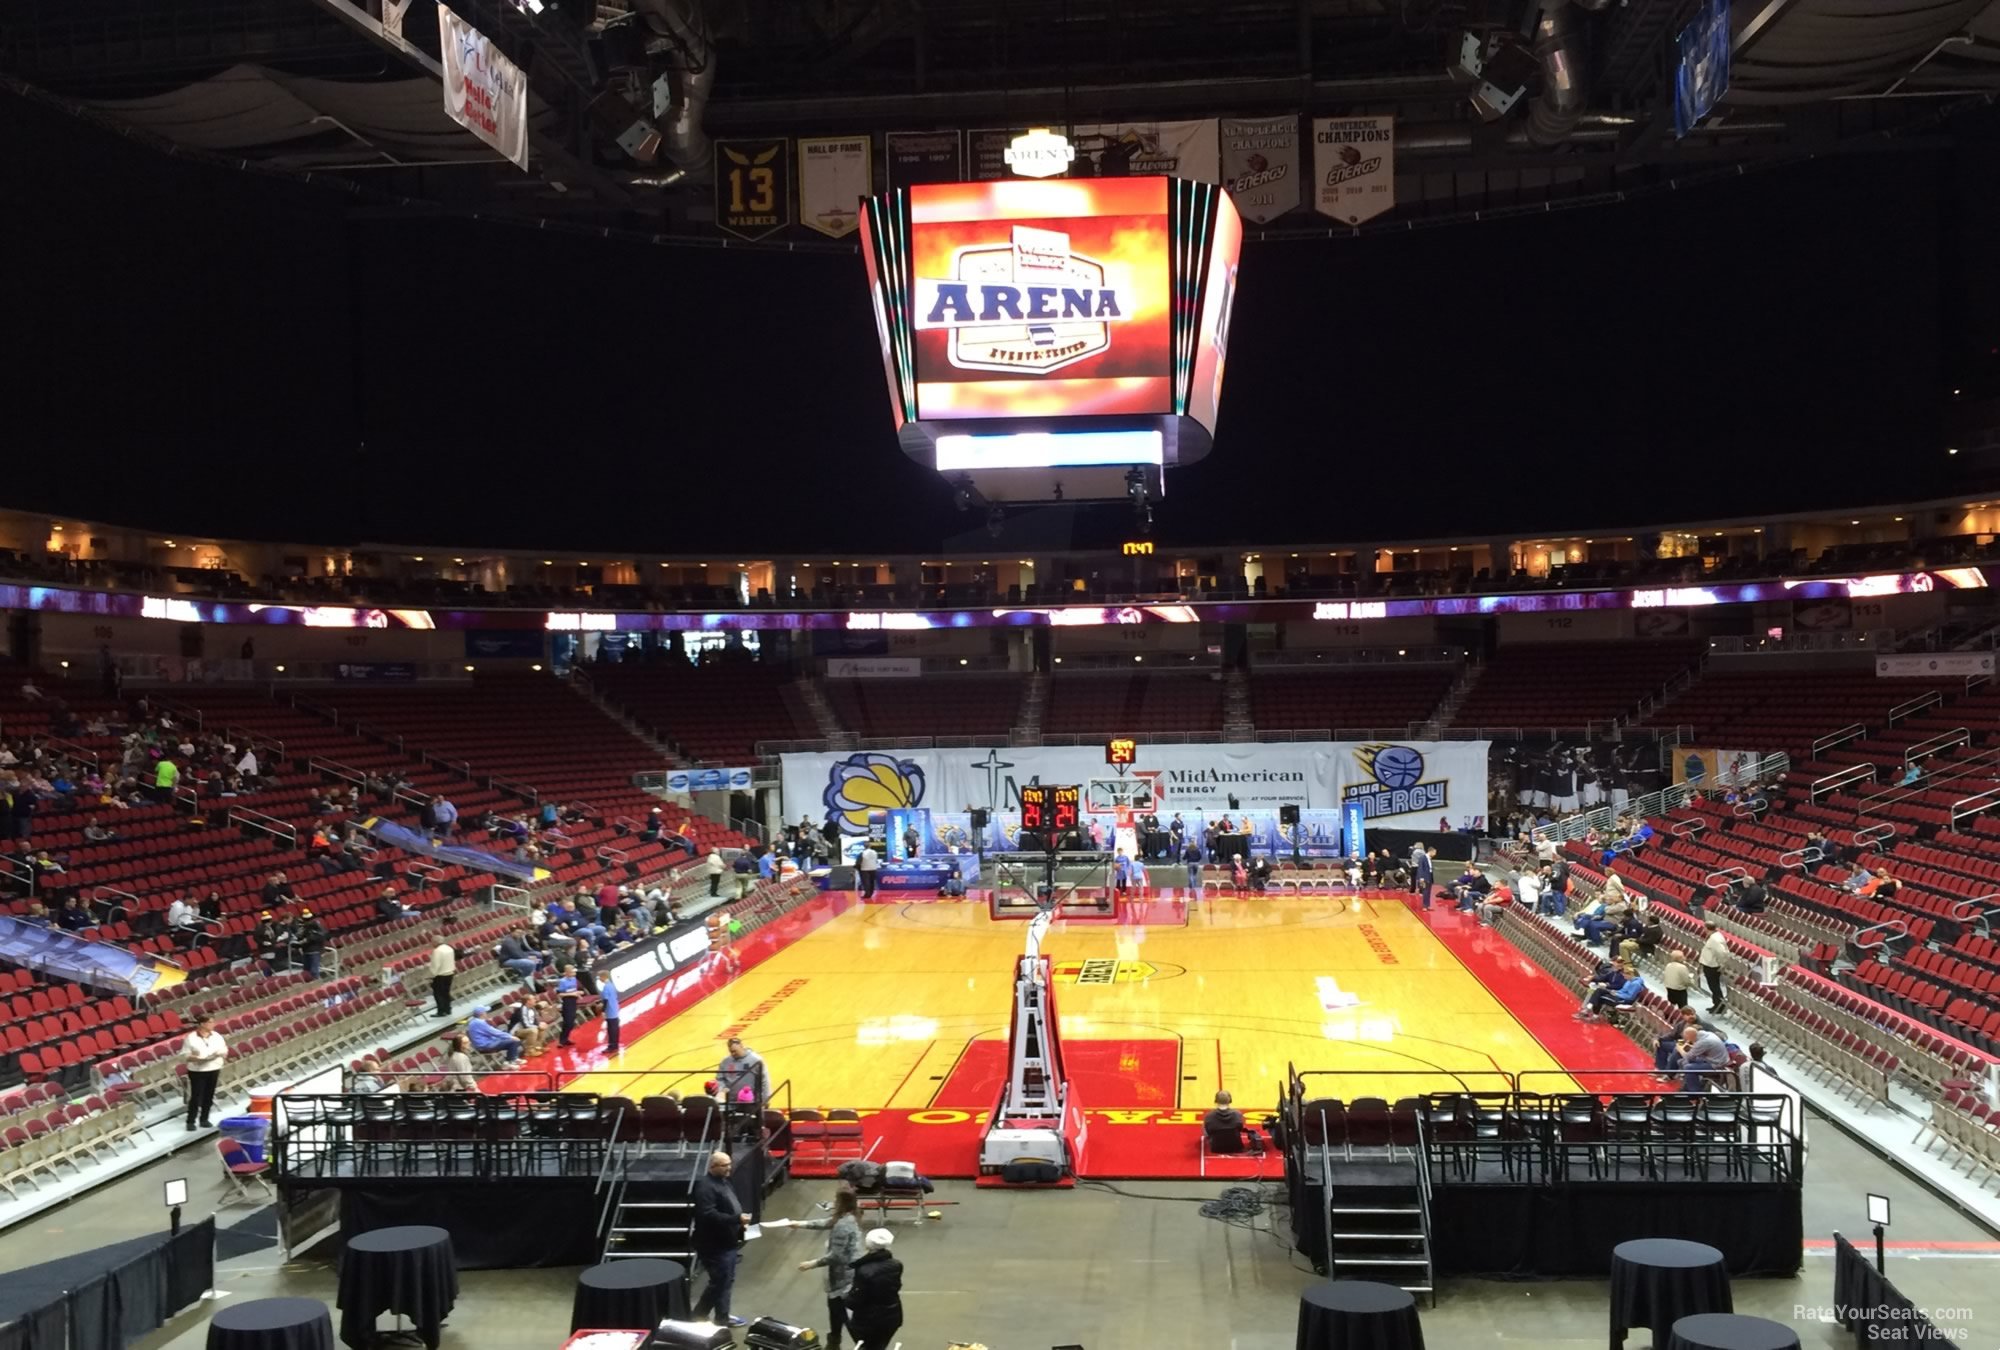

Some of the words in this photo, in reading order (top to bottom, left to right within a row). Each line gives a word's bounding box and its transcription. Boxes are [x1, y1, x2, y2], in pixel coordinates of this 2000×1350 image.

[1329, 120, 1378, 131] CONFERENCE
[1318, 130, 1390, 144] CHAMPIONS
[807, 145, 826, 154] HALL
[828, 144, 839, 153] OF
[840, 143, 863, 153] FAME
[1231, 138, 1292, 150] CHAMPIONS
[1129, 160, 1177, 171] MEADOWS
[1327, 157, 1382, 186] ENERGY
[1235, 165, 1288, 192] ENERGY
[729, 168, 774, 213] 13
[727, 216, 778, 226] WARNER
[927, 284, 1121, 323] ARENA
[1854, 604, 1882, 616] 113
[1548, 618, 1573, 629] 112
[1334, 626, 1360, 636] 112
[1112, 749, 1131, 762] 24
[1168, 768, 1304, 783] MidAmerican
[1170, 786, 1217, 794] ENERGY
[1347, 783, 1381, 797] IOWA
[1025, 803, 1041, 826] 24
[1056, 804, 1075, 828] 24
